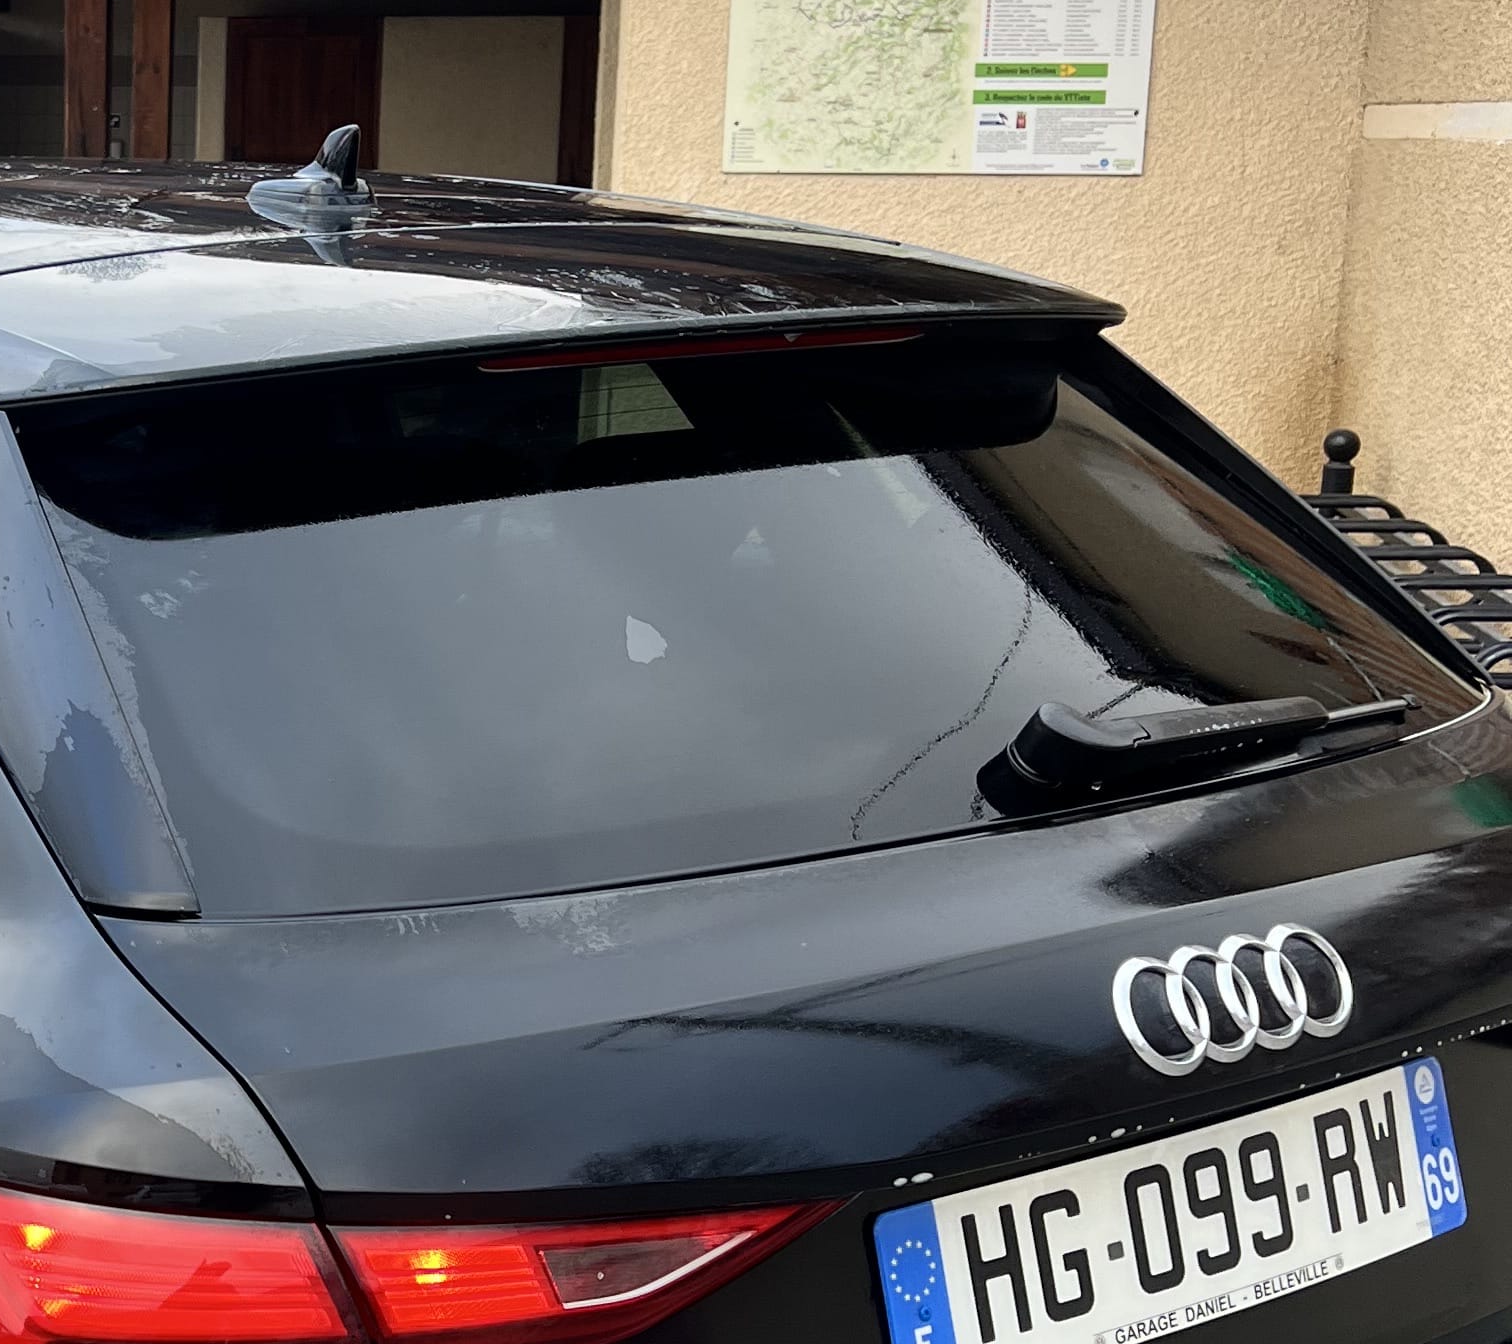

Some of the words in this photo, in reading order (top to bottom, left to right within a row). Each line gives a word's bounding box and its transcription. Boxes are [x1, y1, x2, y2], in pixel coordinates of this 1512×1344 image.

[1422, 1147, 1460, 1210] 69
[961, 1091, 1406, 1344] HG-099-RW
[1185, 1294, 1237, 1323] DANIEL
[1253, 1260, 1330, 1301] BELLEVILLE
